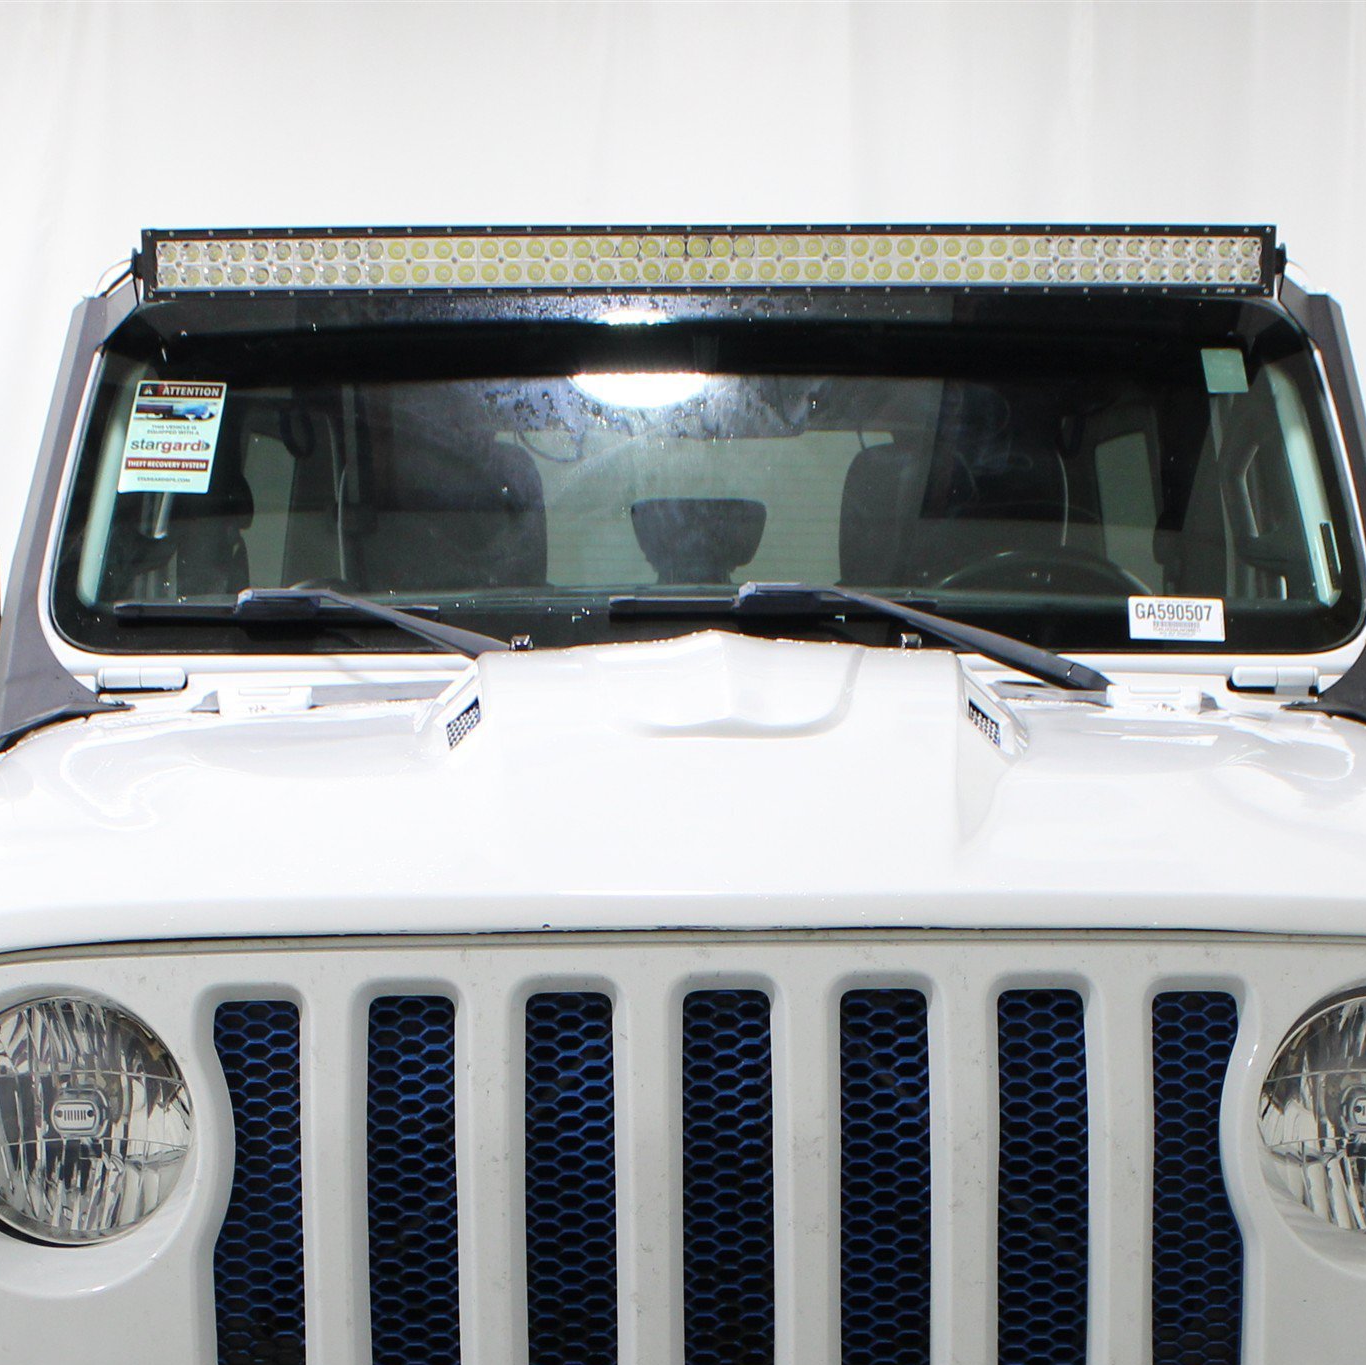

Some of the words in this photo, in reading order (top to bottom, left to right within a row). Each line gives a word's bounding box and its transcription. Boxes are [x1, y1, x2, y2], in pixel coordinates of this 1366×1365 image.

[162, 386, 220, 397] ATTENTION
[130, 439, 202, 453] stargard
[128, 460, 146, 468] THEFT
[147, 460, 180, 469] RECOVERY
[181, 461, 206, 470] SYSTEM
[1135, 603, 1212, 622] GA590507
